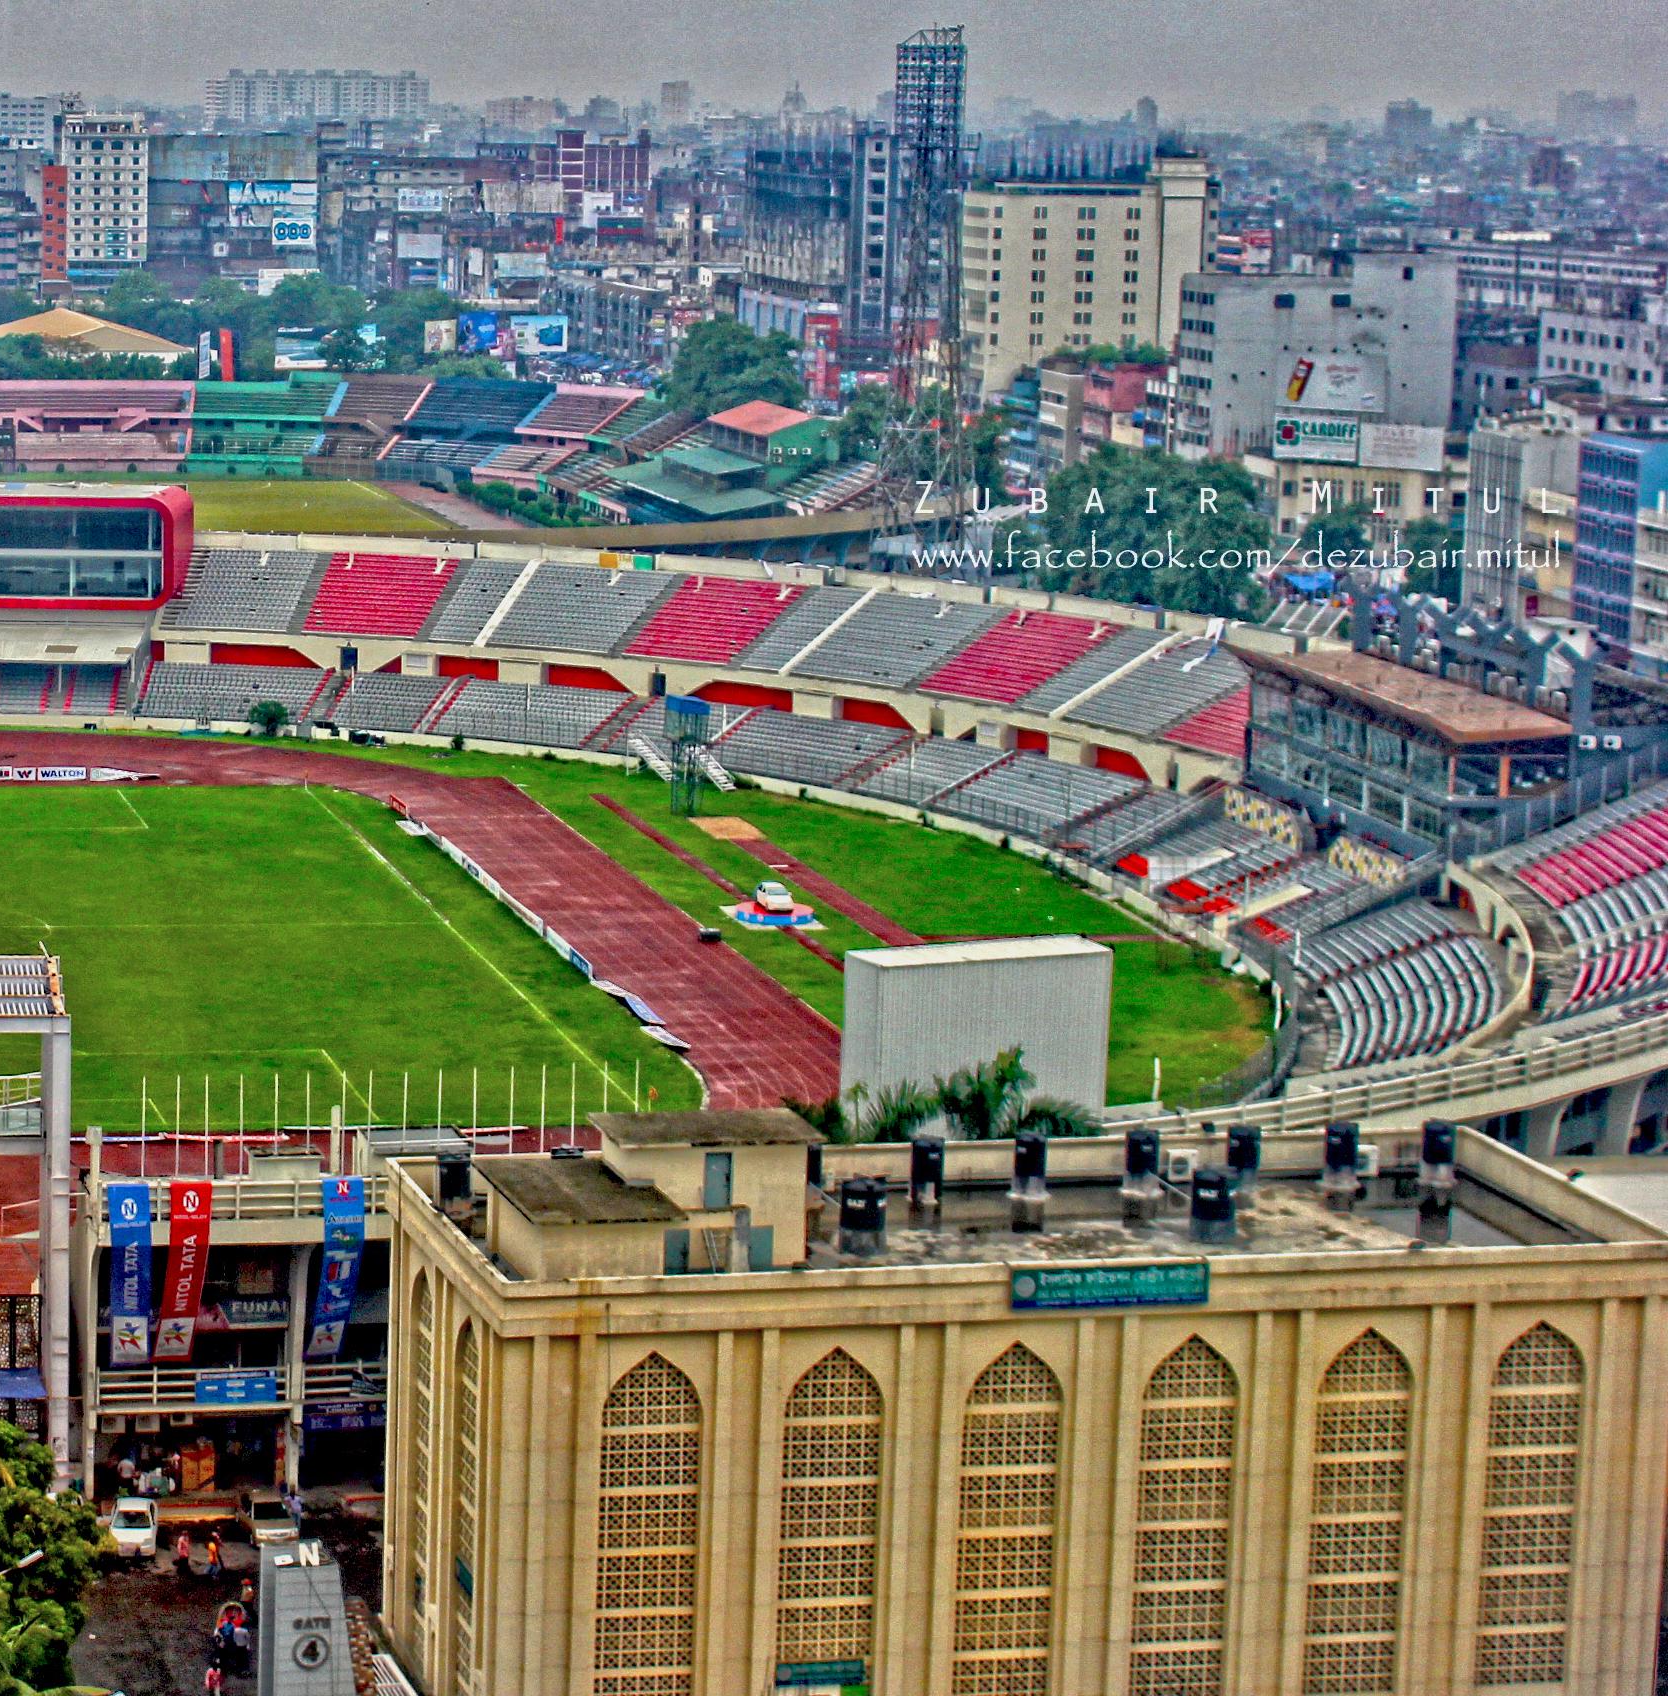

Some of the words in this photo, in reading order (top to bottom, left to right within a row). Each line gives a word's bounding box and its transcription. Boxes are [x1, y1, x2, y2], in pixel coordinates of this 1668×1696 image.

[1302, 421, 1356, 438] CARDIFF
[40, 769, 85, 779] WALTON
[124, 1240, 139, 1273] TATA
[180, 1233, 198, 1272] TATA
[123, 1275, 139, 1311] NITOL
[173, 1274, 193, 1312] NITOL
[233, 1302, 288, 1313] FUNAI
[293, 1616, 331, 1630] GATE
[301, 1640, 320, 1661] 4
